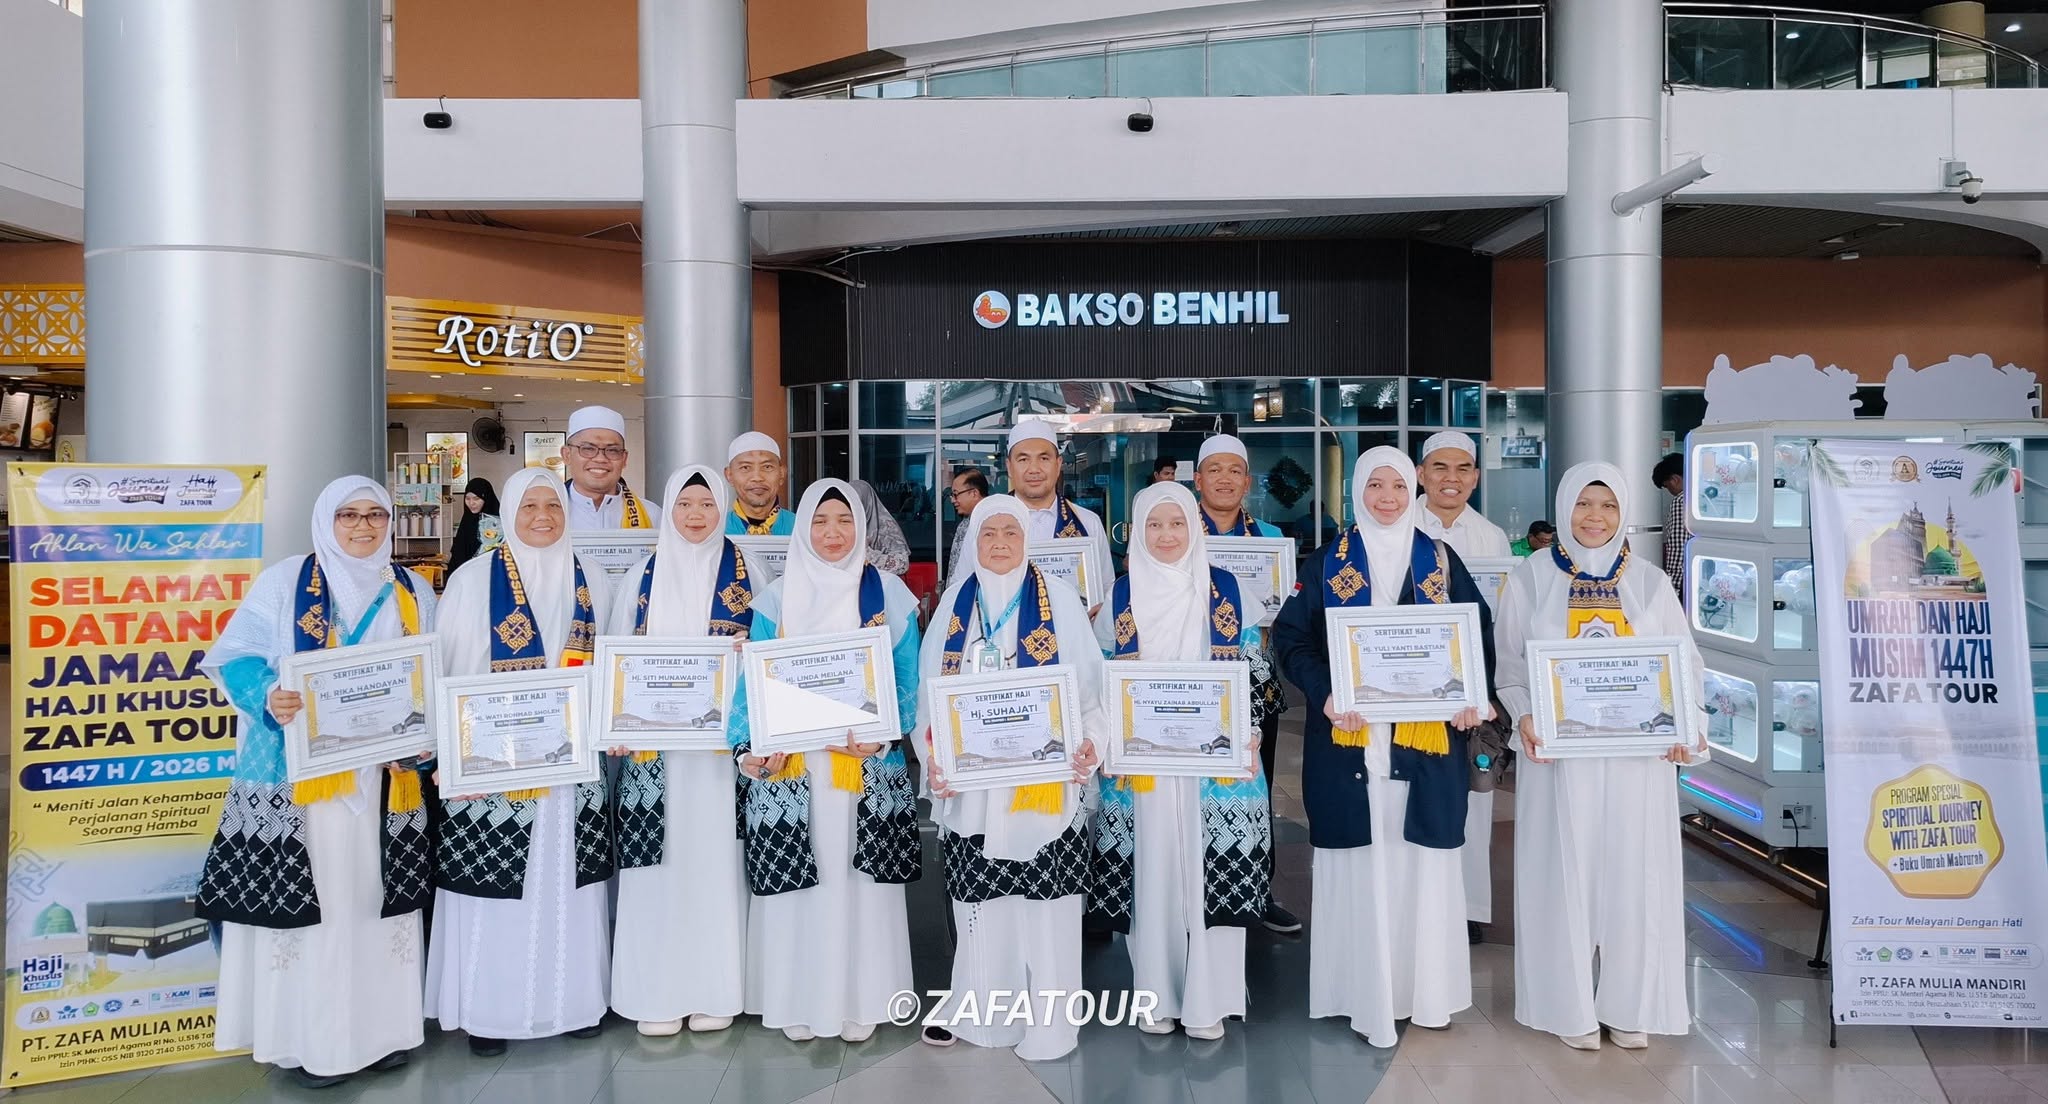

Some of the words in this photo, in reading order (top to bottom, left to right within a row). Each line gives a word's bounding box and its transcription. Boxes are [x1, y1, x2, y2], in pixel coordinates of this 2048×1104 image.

[1017, 291, 1144, 326] BAKSO
[1153, 291, 1289, 325] BENHIL
[107, 481, 169, 497] Journey
[29, 532, 106, 560] Ahlan
[114, 533, 157, 553] Wa
[165, 532, 248, 554] Sahlan
[29, 573, 250, 607] SELAMAT
[1847, 600, 1912, 634] UMRAH
[1917, 600, 1950, 634] DAN
[1955, 601, 1991, 634] HAJI
[1415, 627, 1431, 635] HAJI
[791, 656, 829, 667] SERTIFIKAT
[831, 654, 846, 662] HAJI
[1579, 660, 1619, 668] SERTIFIKAT
[1850, 638, 1927, 679] MUSIM
[1931, 638, 1994, 679] 1447H
[28, 650, 209, 689] JAMAA
[333, 666, 375, 679] SERTIFIKAT
[376, 663, 392, 672] HAJI
[797, 674, 819, 682] LINDA
[821, 669, 854, 679] MEILANA
[334, 686, 355, 697] RIKA
[357, 677, 407, 692] HANDAYANI
[1570, 678, 1582, 686] Hj.
[1585, 676, 1610, 684] ELZA
[1613, 675, 1649, 683] EMILDA
[25, 693, 107, 718] HAJI
[116, 688, 230, 714] KHUSU
[975, 693, 1013, 702] SERTIFIKAT
[1849, 682, 1924, 703] ZAFA
[1927, 683, 1999, 704] TOUR
[971, 711, 984, 719] Hj.
[987, 704, 1038, 717] SUHAJATI
[23, 722, 136, 752] ZAFA
[42, 764, 100, 784] 1447
[106, 763, 125, 780] H
[130, 759, 145, 781] /
[151, 757, 211, 777] 2026
[1890, 786, 1930, 804] PROGRAM
[1931, 784, 1963, 801] SPESIAL
[46, 799, 94, 813] Meniti
[97, 796, 140, 810] Jalan
[1882, 804, 1936, 828] SPIRITUAL
[1938, 800, 1982, 823] JOURNEY
[69, 808, 150, 827] Perjalanan
[151, 804, 211, 820] Spiritual
[82, 822, 143, 838] Seorang
[146, 818, 198, 832] Hamba
[1890, 828, 1919, 850] WITH
[1921, 826, 1948, 848] ZAFA
[1950, 824, 1977, 846] TOUR
[1899, 857, 1919, 872] Buku
[1921, 855, 1945, 870] Umrah
[1947, 853, 1984, 868] Mabrurah
[1851, 916, 1874, 926] Zafa
[1877, 916, 1903, 926] Tour
[1905, 916, 1954, 929] Melayani
[1957, 917, 1999, 929] Dengan
[2002, 917, 2023, 927] Hati
[22, 954, 63, 978] Haji
[23, 971, 63, 983] Khusus
[1860, 977, 1878, 988] PT.
[1882, 977, 1916, 989] ZAFA
[1919, 977, 1963, 989] MULIA
[1967, 979, 2026, 990] MANDIRI
[172, 989, 190, 998] KAN
[22, 1037, 50, 1052] PT.
[55, 1029, 104, 1048] ZAFA
[110, 1020, 171, 1041] MULIA
[177, 1014, 216, 1032] MAN
[30, 1055, 46, 1063] Izin
[85, 1045, 118, 1056] Menteri
[120, 1041, 152, 1051] Agama
[163, 1036, 177, 1044] No.
[178, 1034, 200, 1043] U.516
[60, 1060, 75, 1068] Izin
[77, 1057, 100, 1066] PIHK:
[102, 1055, 118, 1063] OSS
[120, 1052, 134, 1060] NIB
[136, 1049, 155, 1058] 9120
[156, 1046, 175, 1055] 2140
[177, 1043, 196, 1053] 5105
